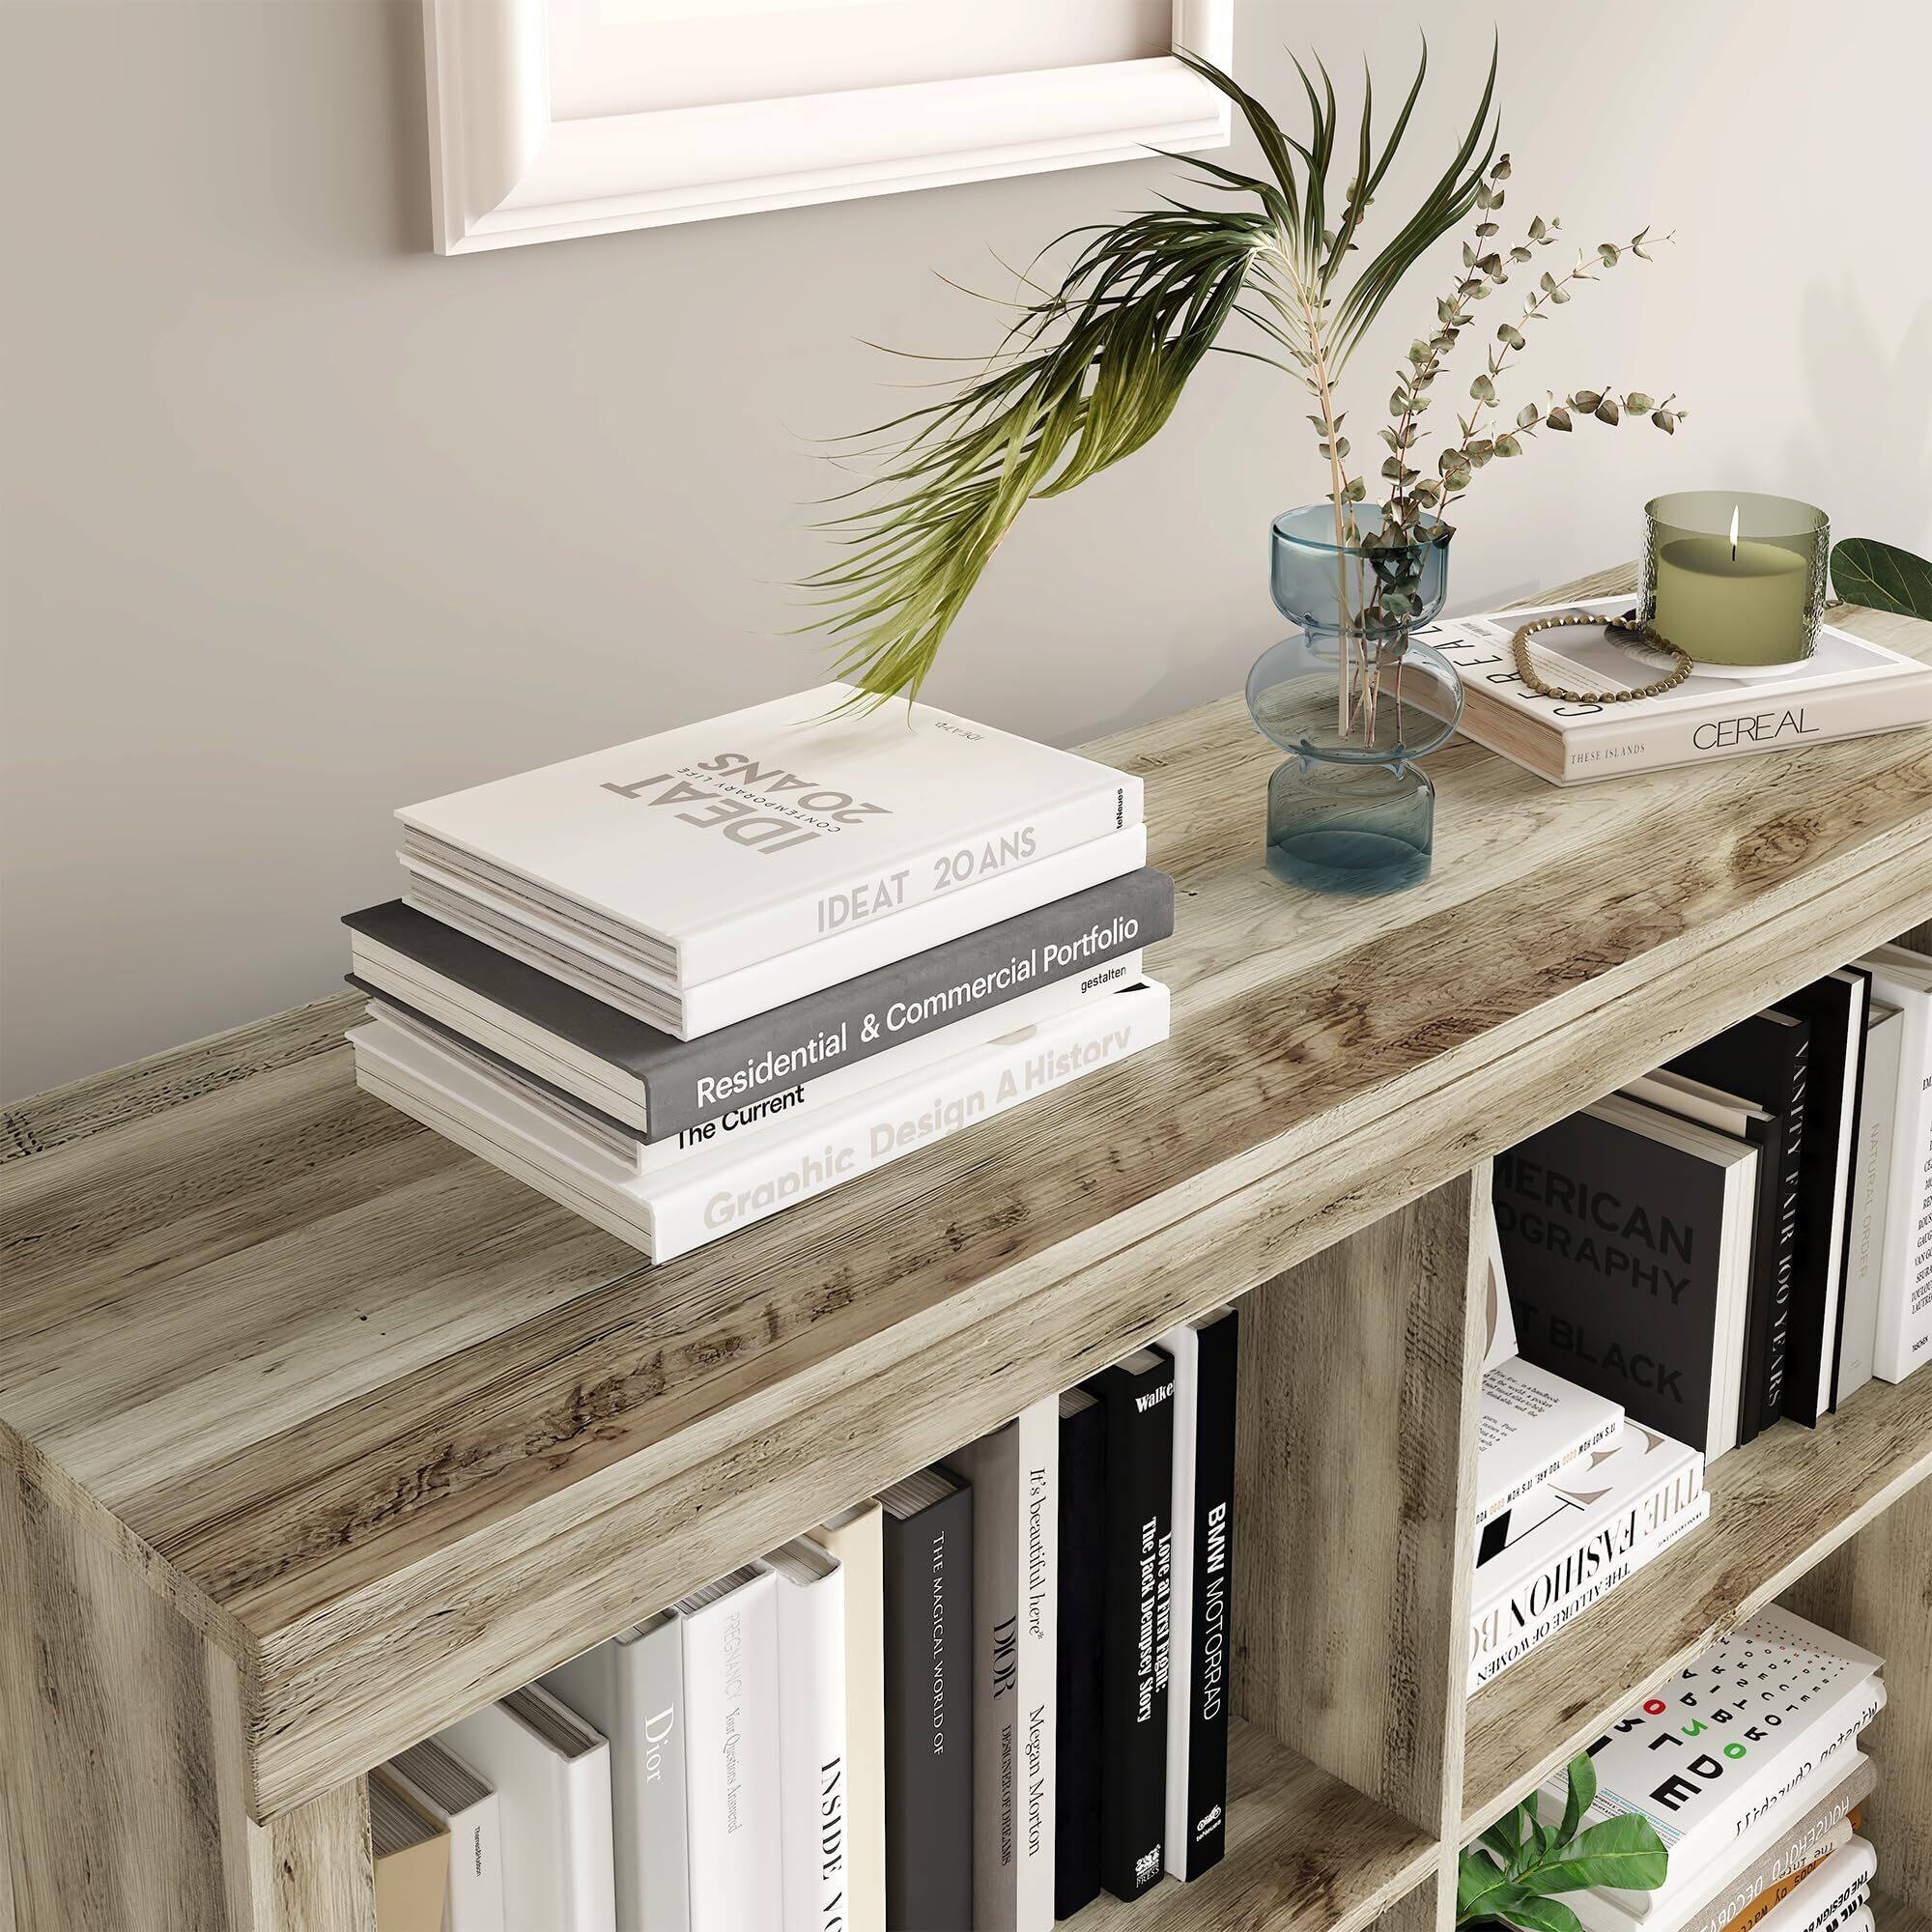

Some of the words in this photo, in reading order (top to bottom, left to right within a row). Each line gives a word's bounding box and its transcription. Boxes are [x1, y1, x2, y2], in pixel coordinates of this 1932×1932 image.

[1571, 749, 1601, 764] THESE
[1605, 743, 1646, 760] ISLANDS
[1692, 708, 1820, 750] CEREAL
[676, 766, 711, 783] LIFE
[696, 753, 820, 794] ANS
[599, 774, 823, 855] IDEAT
[716, 781, 841, 834] CONTEMPORARY
[798, 791, 894, 824] 20
[818, 869, 910, 933] IDEAT
[933, 849, 975, 891] 20
[979, 826, 1037, 875] ANS
[1080, 964, 1127, 993] gestalten
[696, 1022, 847, 1108] Residential
[860, 1012, 880, 1043] &
[886, 956, 1037, 1033] Commercial
[1043, 915, 1139, 973] Portfolio
[722, 1085, 806, 1131] Current
[1787, 1040, 1809, 1155] VANITY
[704, 1143, 856, 1230] Graphic
[869, 1090, 985, 1160] Design
[996, 1068, 1017, 1105] A
[1861, 1121, 1880, 1208] NATURAL
[1780, 1170, 1799, 1245] FAIR
[1858, 1213, 1872, 1279] ORDER
[1548, 1314, 1684, 1405] BLACK
[1769, 1310, 1788, 1406] YEARS
[1135, 1379, 1175, 1413] Walke
[1030, 1467, 1046, 1496] It's
[1643, 1468, 1700, 1536] THE
[933, 1530, 945, 1574] THE
[1029, 1495, 1046, 1591] beautiful
[1142, 1516, 1156, 1554] The
[1207, 1501, 1226, 1575] BMW
[1140, 1552, 1156, 1598] Jack
[1507, 1509, 1637, 1638] FASHION
[1552, 1579, 1605, 1628] ALLURE
[1605, 1562, 1632, 1593] THE
[933, 1577, 944, 1660] MAGICAL
[1138, 1595, 1155, 1677] Dempsey
[1204, 1576, 1224, 1721] MOTORRAD
[1532, 1620, 1550, 1643] OF
[724, 1610, 743, 1702] PREGNANCY
[993, 1614, 1016, 1701] DIOR
[1476, 1639, 1530, 1688] WOMEN
[725, 1707, 741, 1730] Your
[933, 1660, 944, 1729] WORLD
[1137, 1676, 1153, 1723] Story
[644, 1702, 674, 1785] Dior
[723, 1732, 741, 1785] Questions
[933, 1732, 945, 1754] OF
[1001, 1724, 1011, 1792] DESIGNER
[1025, 1704, 1044, 1777] Megan
[726, 1783, 743, 1834] Answered
[821, 1757, 841, 1881] INSIDE
[1001, 1807, 1011, 1866] DREAMS
[1028, 1776, 1044, 1858] Morton
[1816, 1888, 1851, 1929] DESIGN
[1851, 1870, 1867, 1895] THE
